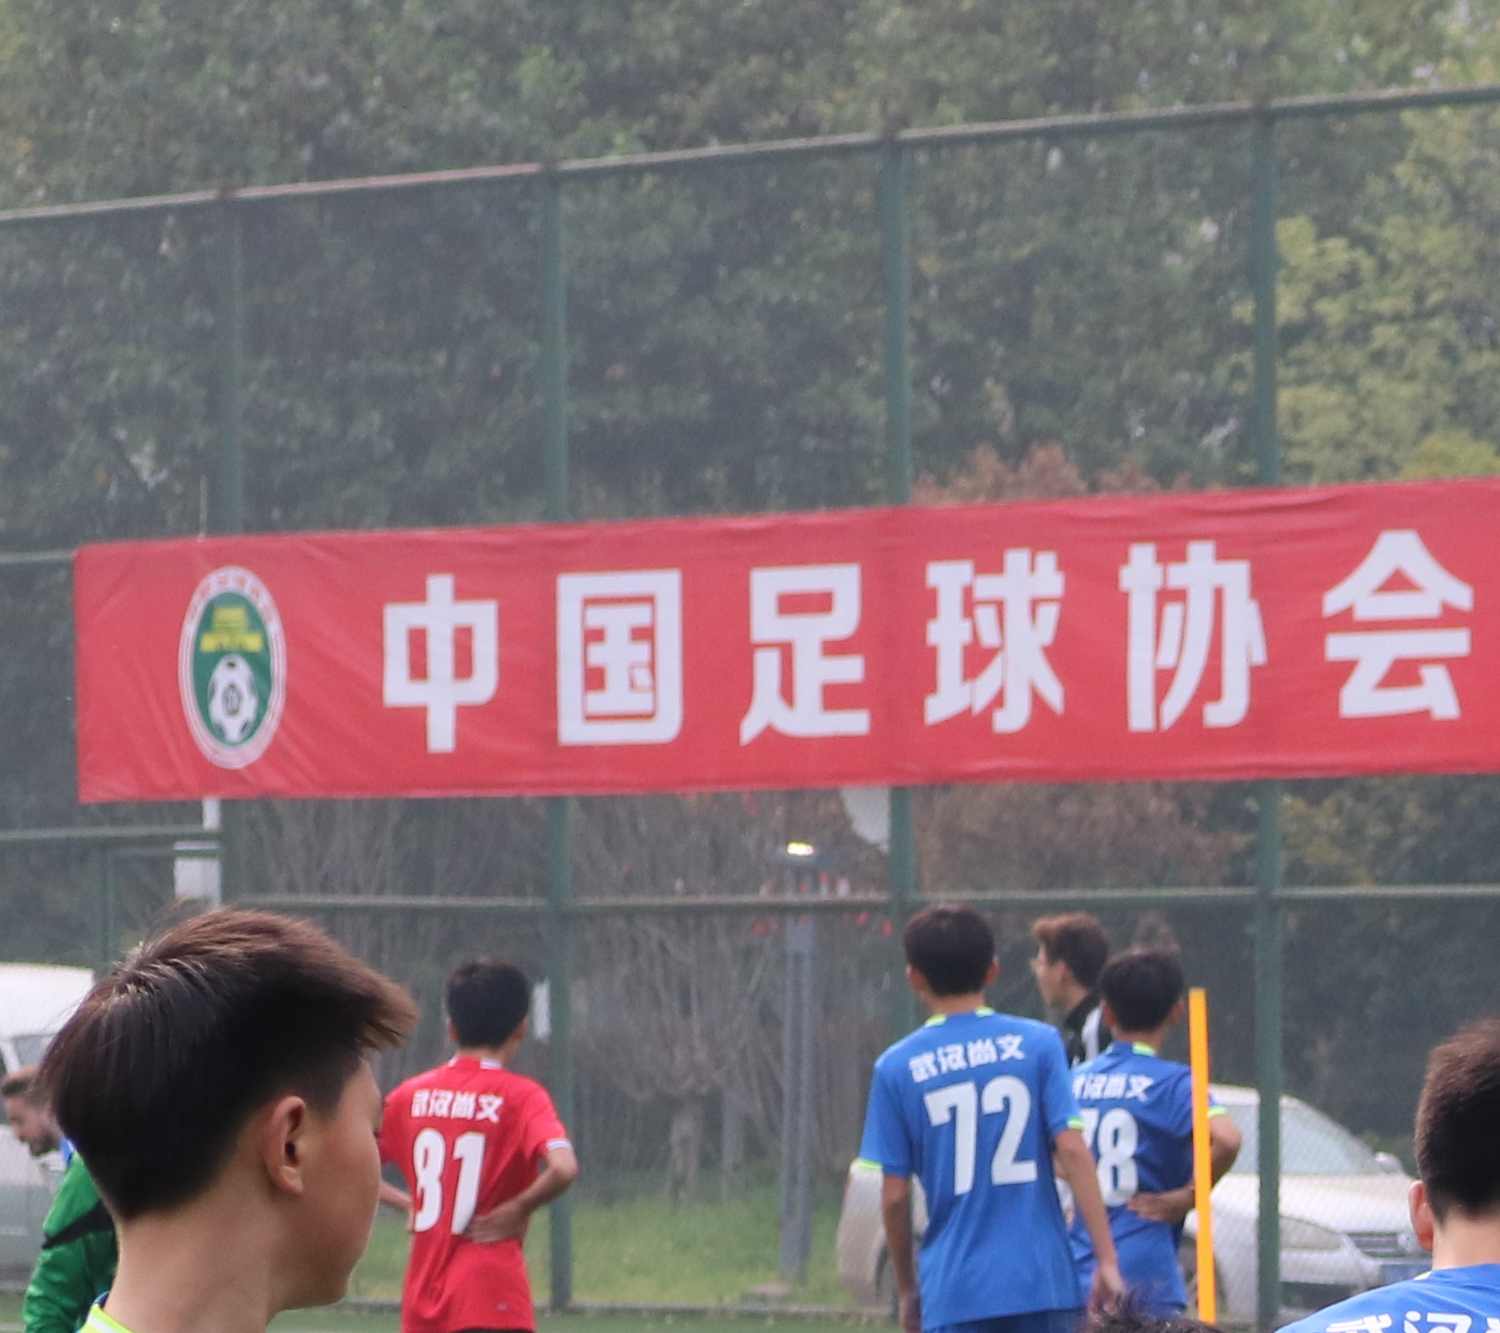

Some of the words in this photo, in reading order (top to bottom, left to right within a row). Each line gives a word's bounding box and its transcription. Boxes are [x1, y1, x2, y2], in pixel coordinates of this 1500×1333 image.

[908, 1033, 1026, 1083] 武汉尚文
[413, 1127, 486, 1235] 81
[924, 1075, 1038, 1196] 72
